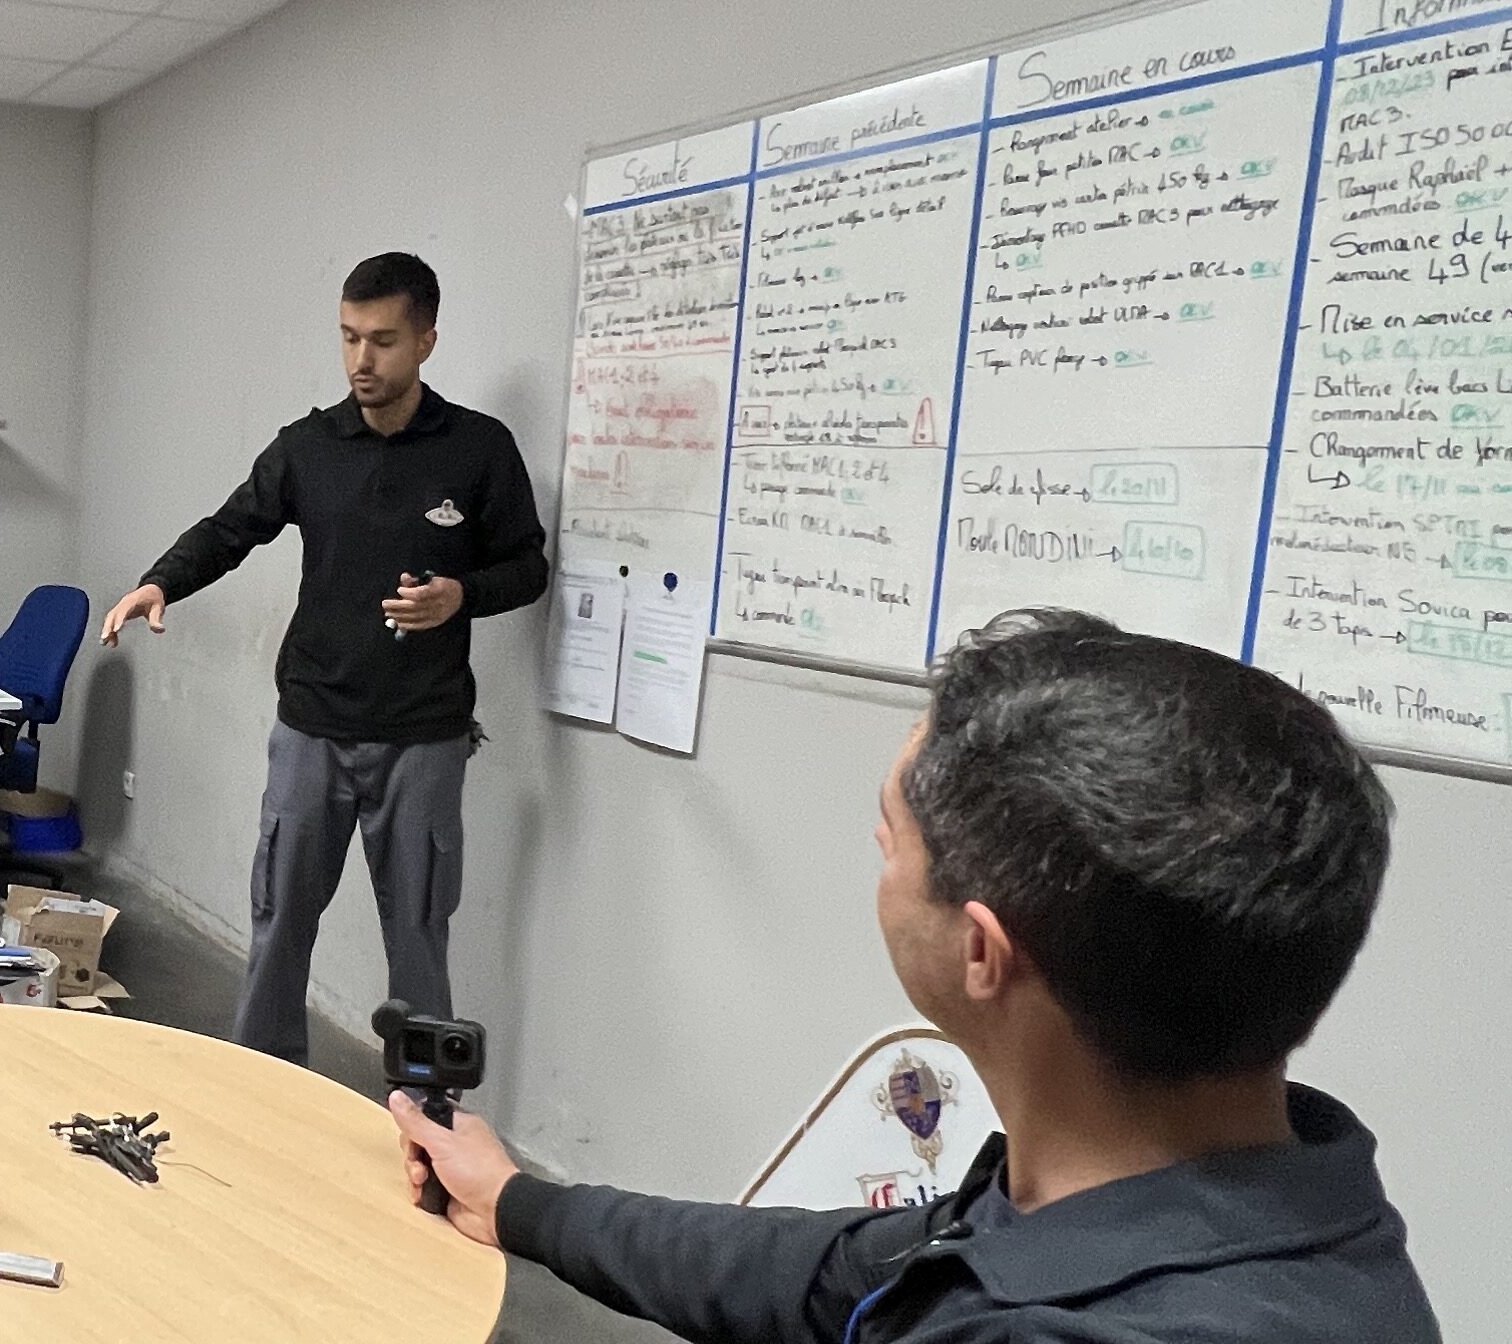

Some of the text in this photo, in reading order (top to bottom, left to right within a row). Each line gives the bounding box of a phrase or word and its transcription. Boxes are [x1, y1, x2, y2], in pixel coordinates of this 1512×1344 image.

[1351, 40, 1490, 80] Intervention
[1016, 45, 1236, 109] Semaine en cours
[763, 105, 927, 167] Semaine précédente
[621, 141, 694, 197] Sécurité
[1408, 154, 1489, 197] Raphaël
[1452, 217, 1485, 247] de
[1428, 253, 1470, 285] 49
[1320, 303, 1374, 334] Mise
[1384, 315, 1406, 329] en
[1412, 306, 1493, 326] service
[1314, 372, 1392, 398] Batterie
[1311, 398, 1439, 422] commandées
[1437, 437, 1464, 460] de
[1285, 575, 1388, 609] Intervention
[1397, 588, 1471, 621] Sovica
[1282, 608, 1303, 631] de
[1308, 611, 1327, 632] 3
